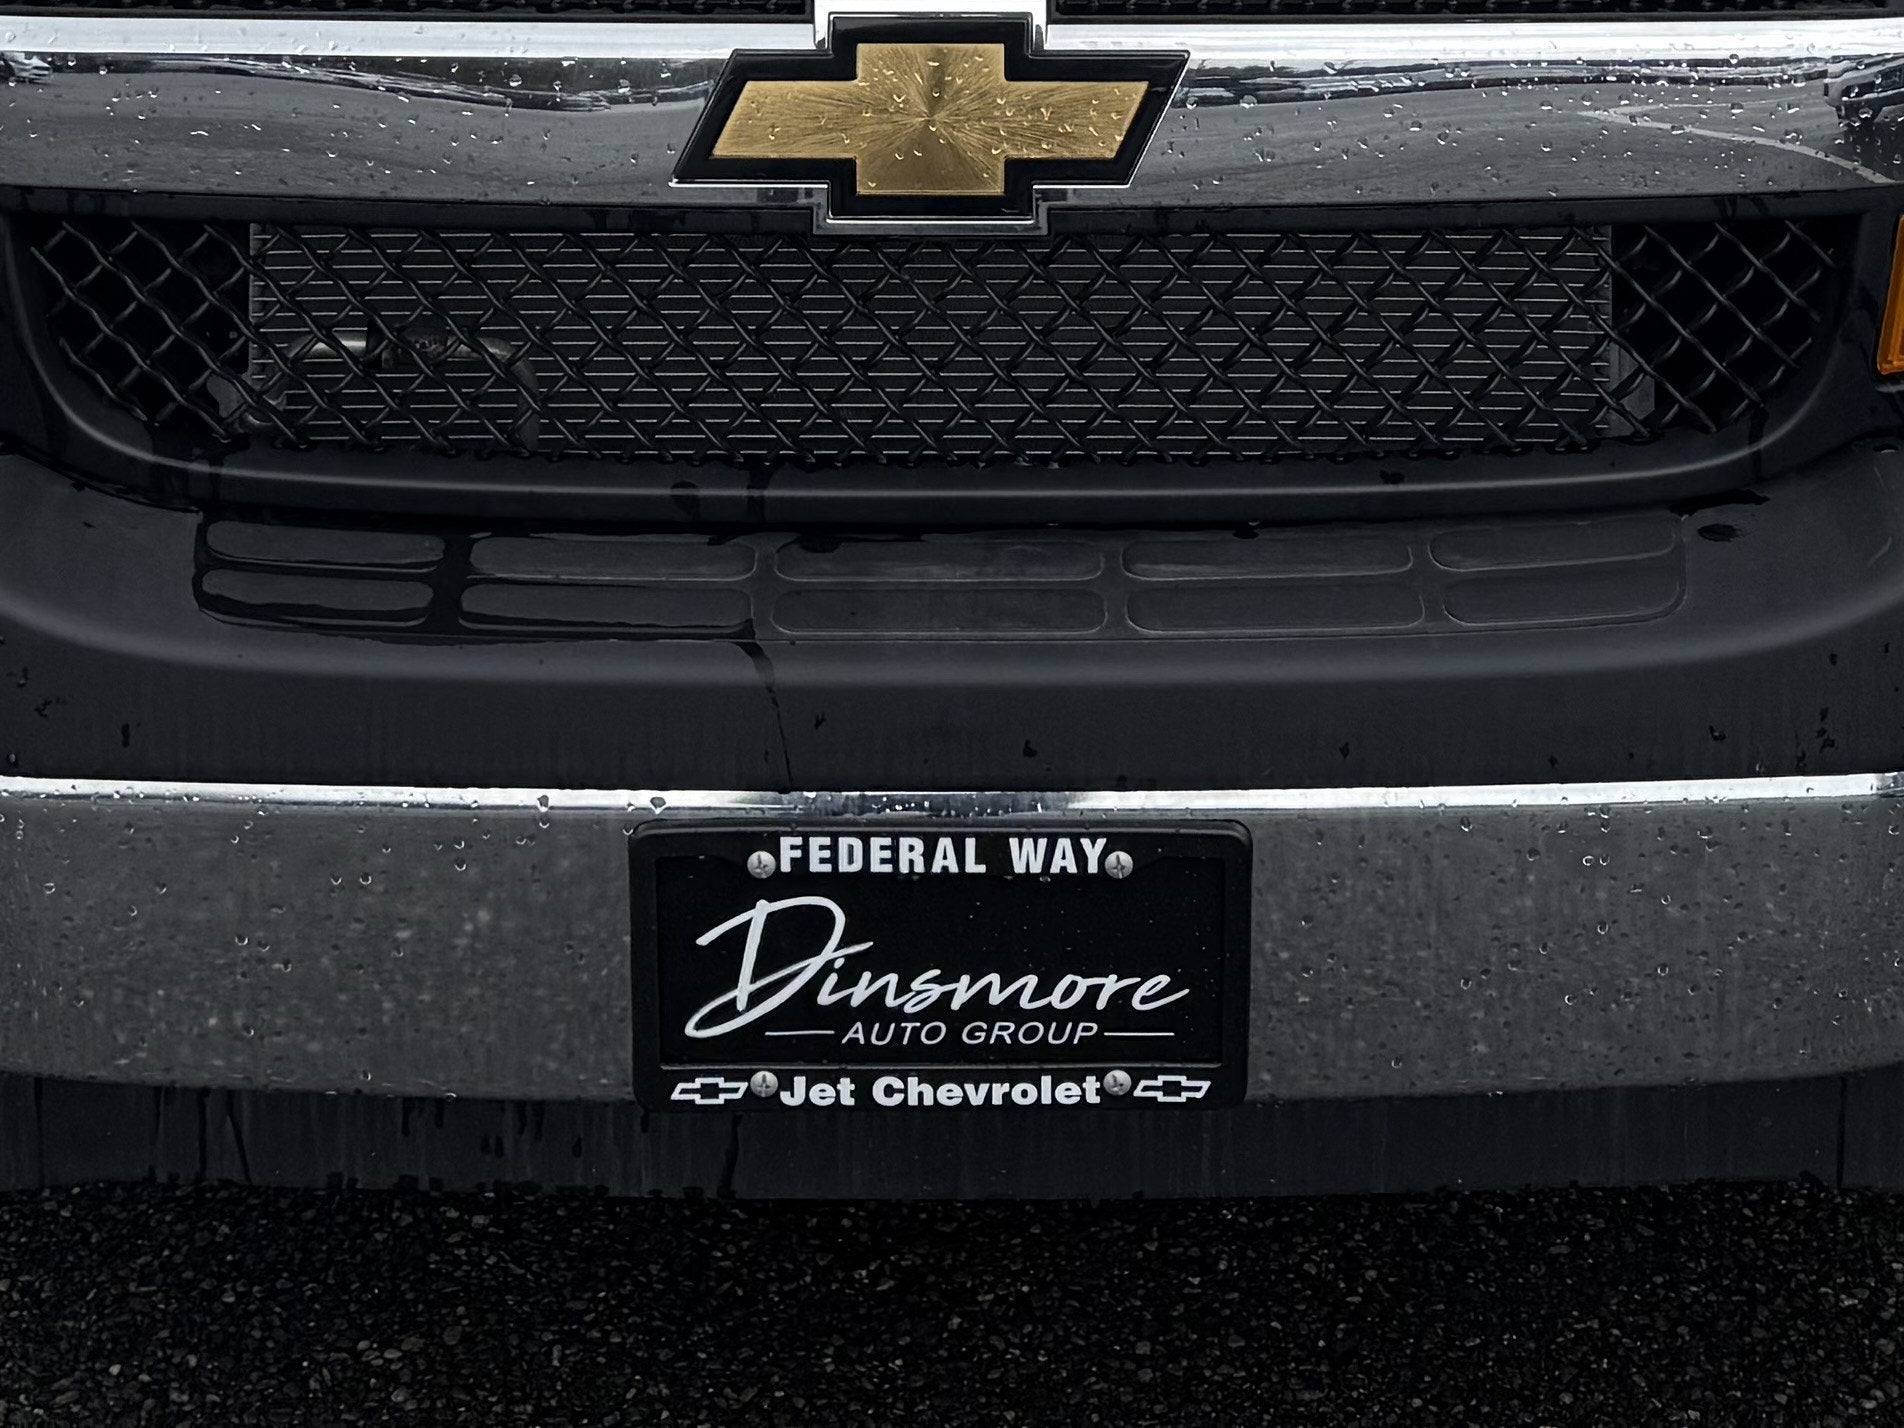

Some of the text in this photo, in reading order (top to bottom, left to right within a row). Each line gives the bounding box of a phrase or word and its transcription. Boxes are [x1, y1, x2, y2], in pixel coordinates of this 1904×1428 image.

[779, 836, 1108, 874] FEDERAL WAY
[684, 895, 1190, 1039] Dinsmore
[840, 1021, 1098, 1045] AUTO GROUP
[779, 1074, 1101, 1107] Jet Chevrolet
